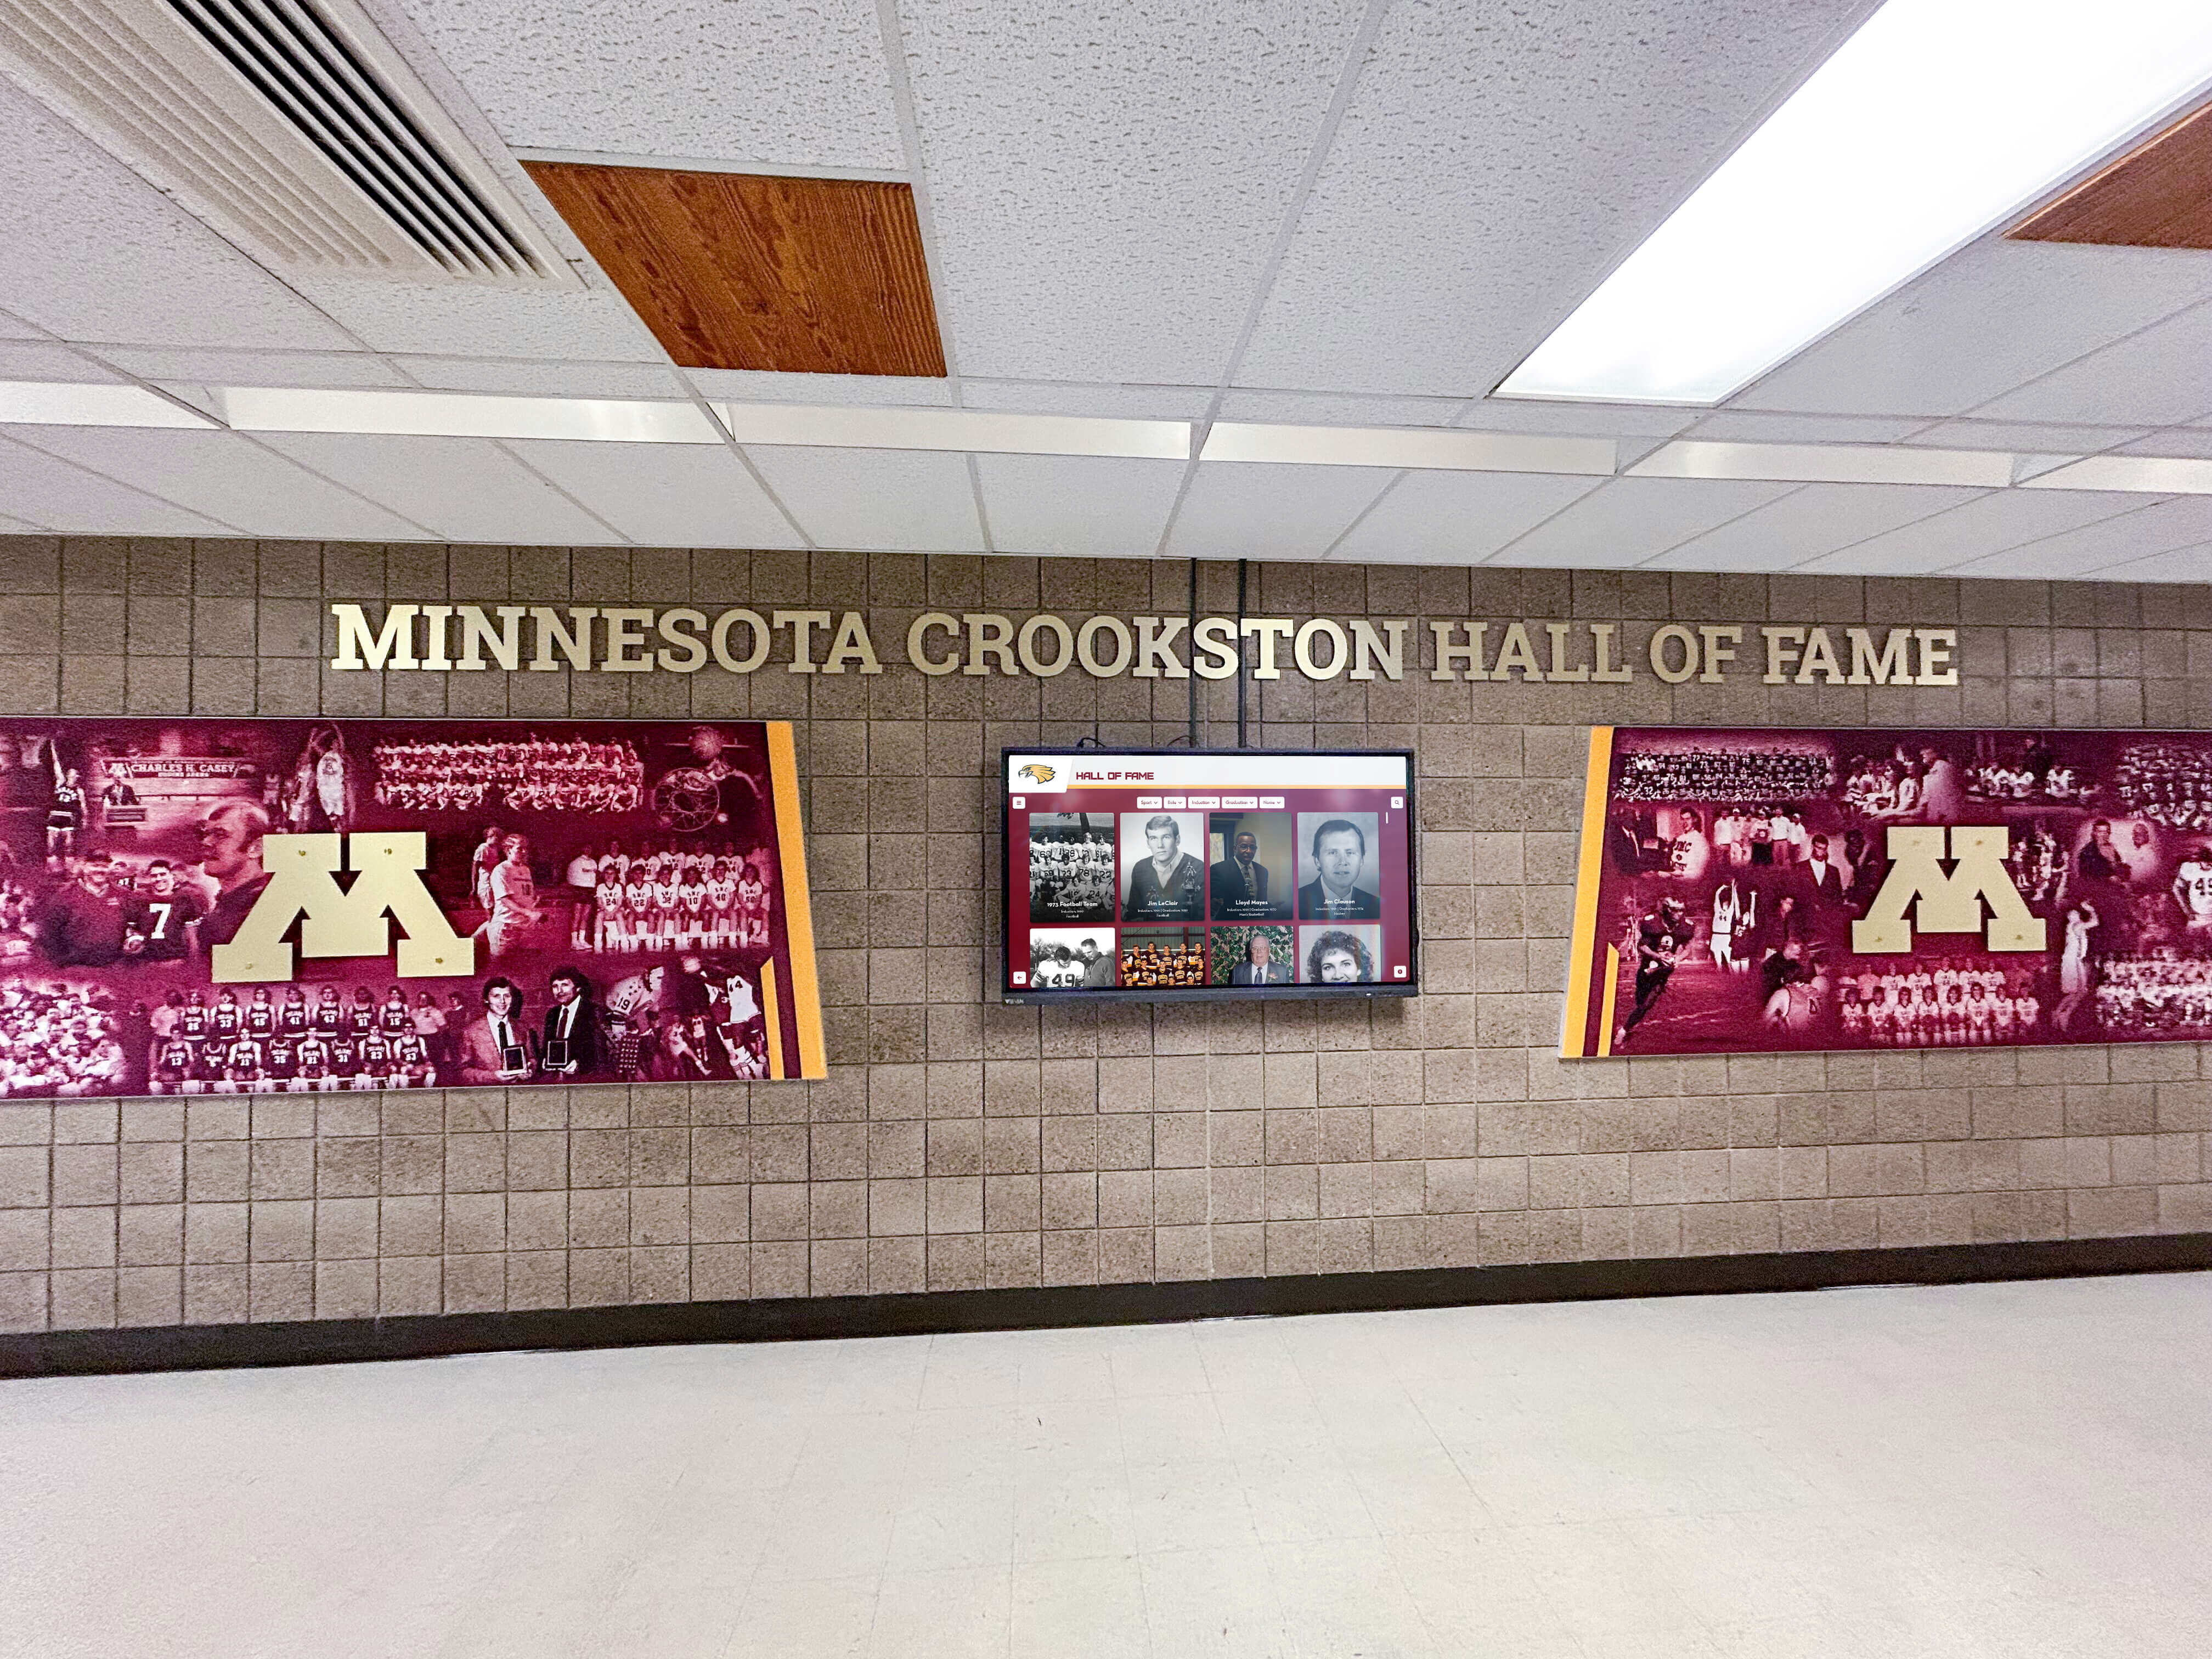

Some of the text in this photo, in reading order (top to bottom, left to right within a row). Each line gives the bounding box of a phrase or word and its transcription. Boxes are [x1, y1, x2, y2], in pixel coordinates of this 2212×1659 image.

[330, 604, 1959, 686] MINNESOTA CROOKSTON HALL OF FAME
[131, 763, 183, 772] CHARLES
[199, 763, 234, 772] CASEY
[1076, 772, 1154, 780] HALL OF FAME
[634, 899, 645, 907] 22
[689, 897, 698, 905] 10
[149, 903, 172, 939] 7
[1052, 973, 1075, 986] 49
[618, 996, 630, 1011] 19
[220, 1019, 232, 1028] 33
